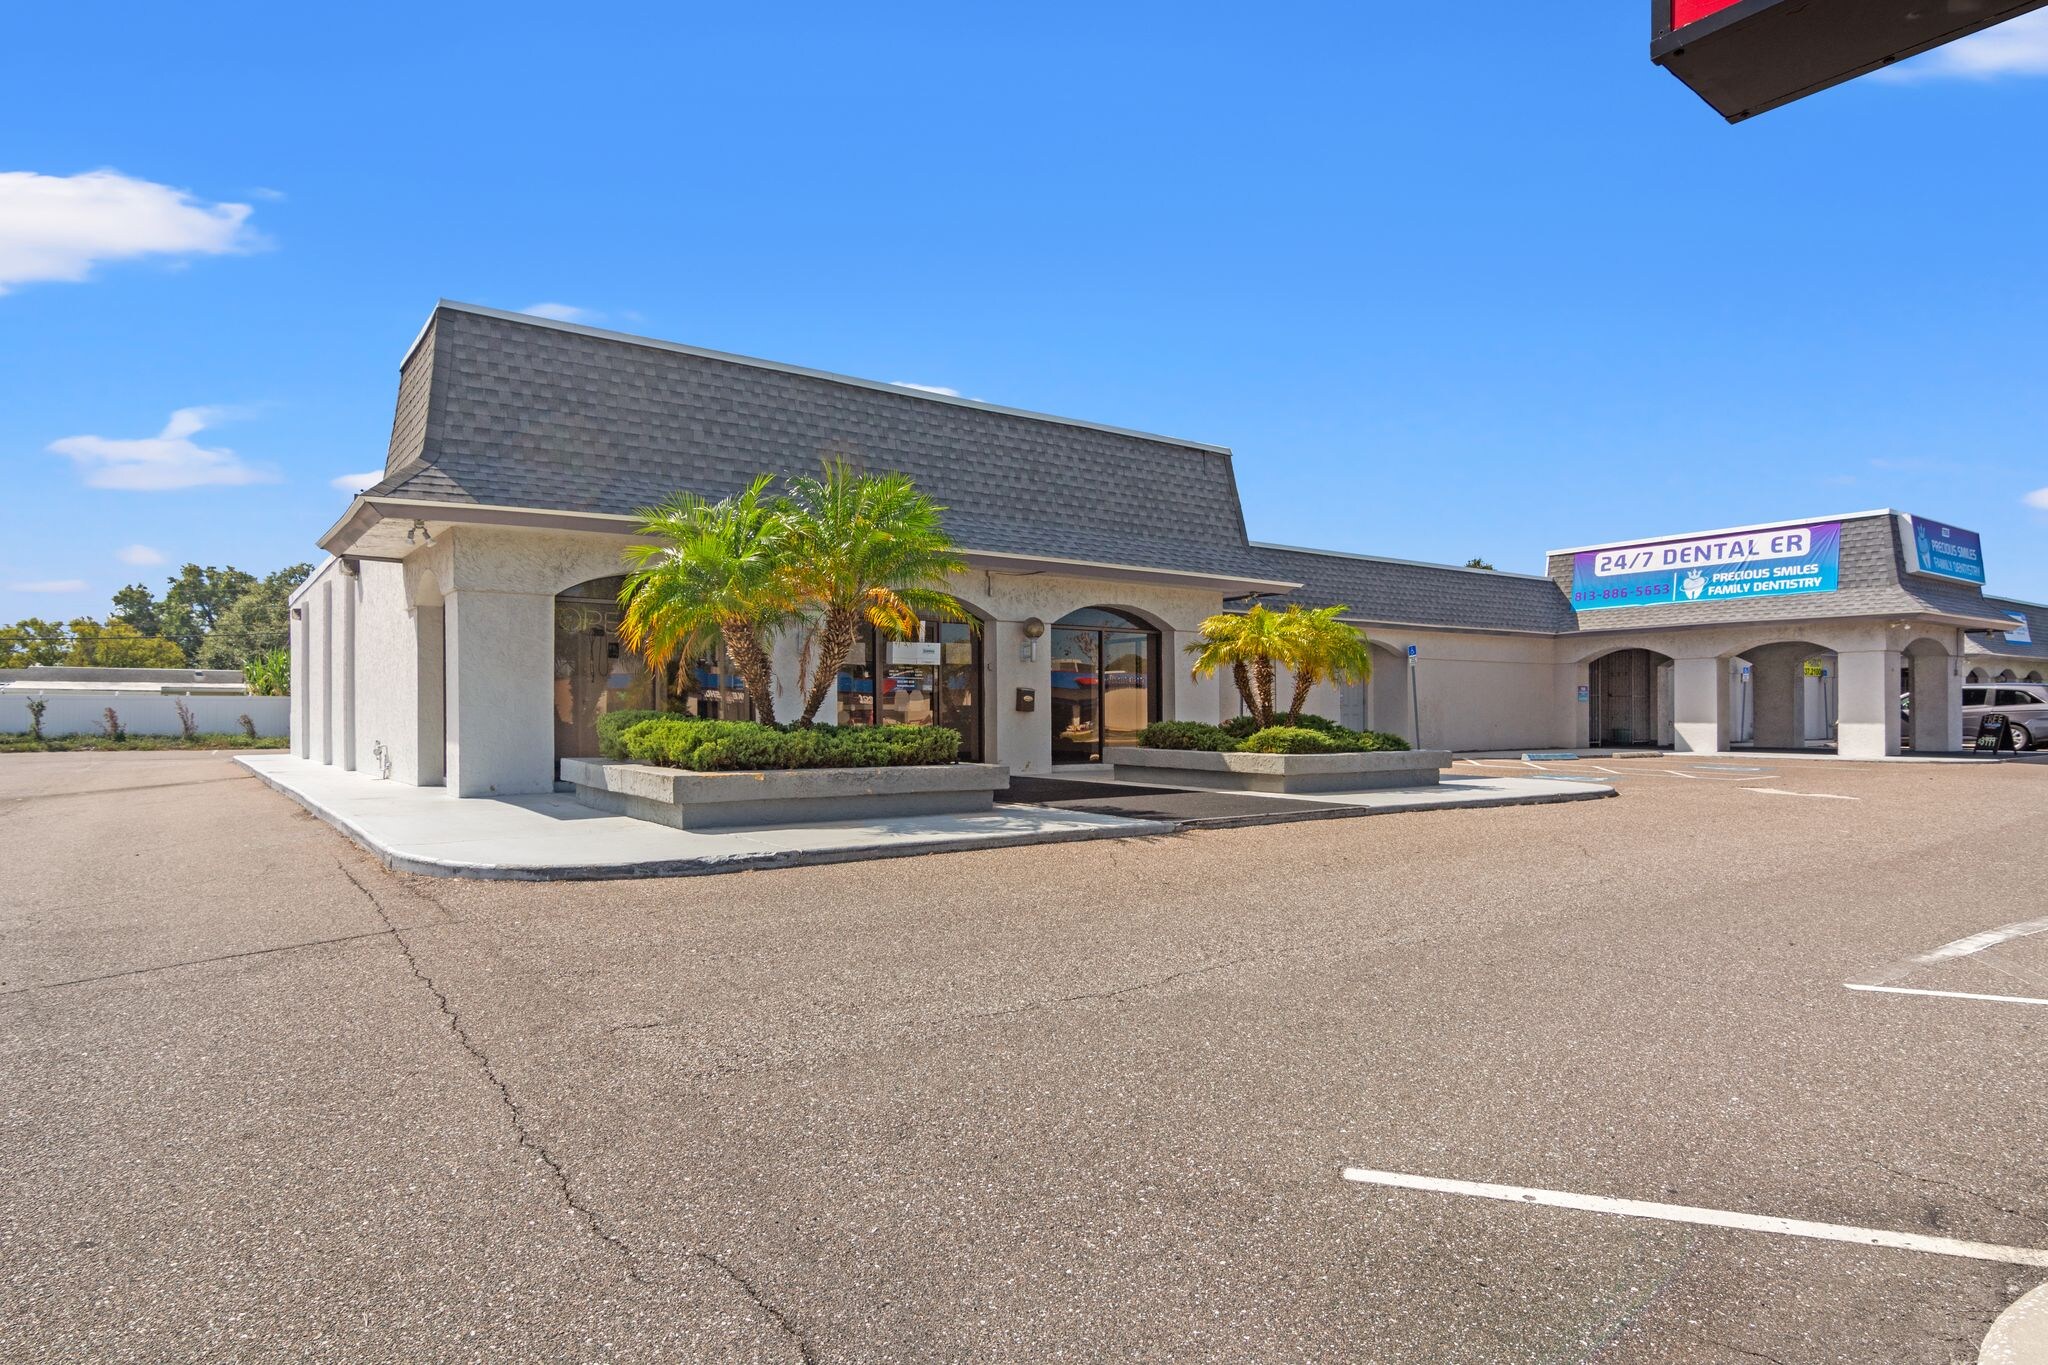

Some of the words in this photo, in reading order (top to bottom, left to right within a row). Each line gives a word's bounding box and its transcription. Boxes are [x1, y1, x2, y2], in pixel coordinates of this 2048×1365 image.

[1600, 551, 1653, 572] 24/7
[1663, 539, 1759, 565] DENTAL
[1771, 534, 1803, 553] ER
[1931, 540, 1957, 557] PRECIOUS
[1957, 545, 1977, 560] SMILES
[1712, 568, 1770, 582] PRECIOUS
[1773, 564, 1819, 577] SMILES
[1574, 584, 1670, 601] 813-886-5653
[1708, 582, 1750, 595] FAMILY
[1753, 577, 1822, 592] DENTISTRY
